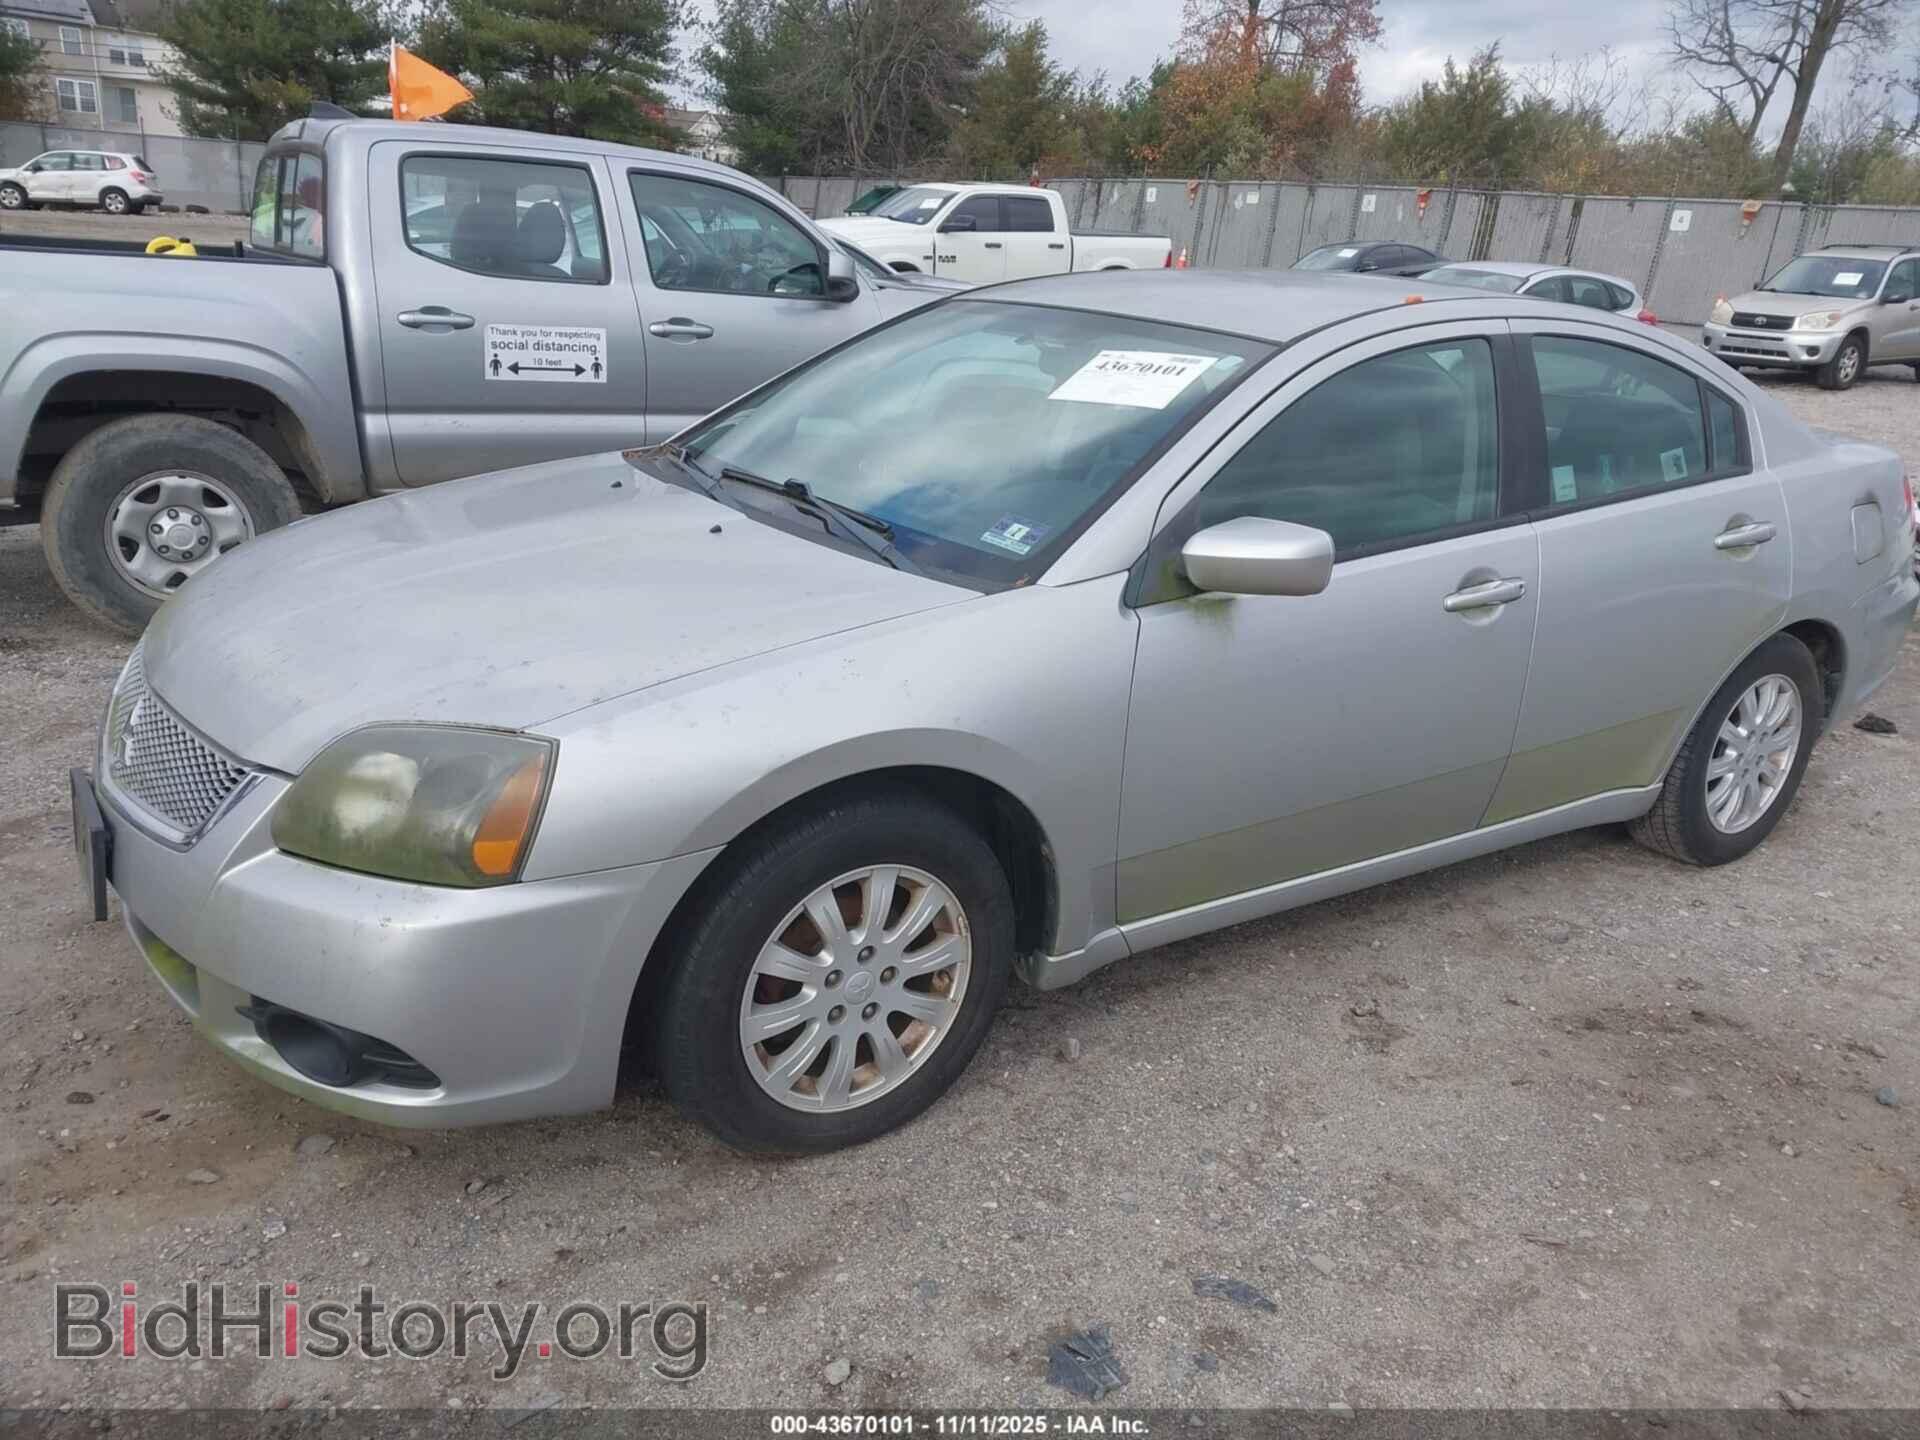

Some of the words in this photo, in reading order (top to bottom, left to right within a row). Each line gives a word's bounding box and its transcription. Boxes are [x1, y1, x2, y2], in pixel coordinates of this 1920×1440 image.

[490, 327, 517, 336] Thank
[521, 330, 537, 339] you
[540, 329, 552, 337] for
[554, 331, 601, 341] respecting
[490, 340, 529, 350] social
[533, 358, 542, 366] 10
[1095, 360, 1187, 376] 43670101
